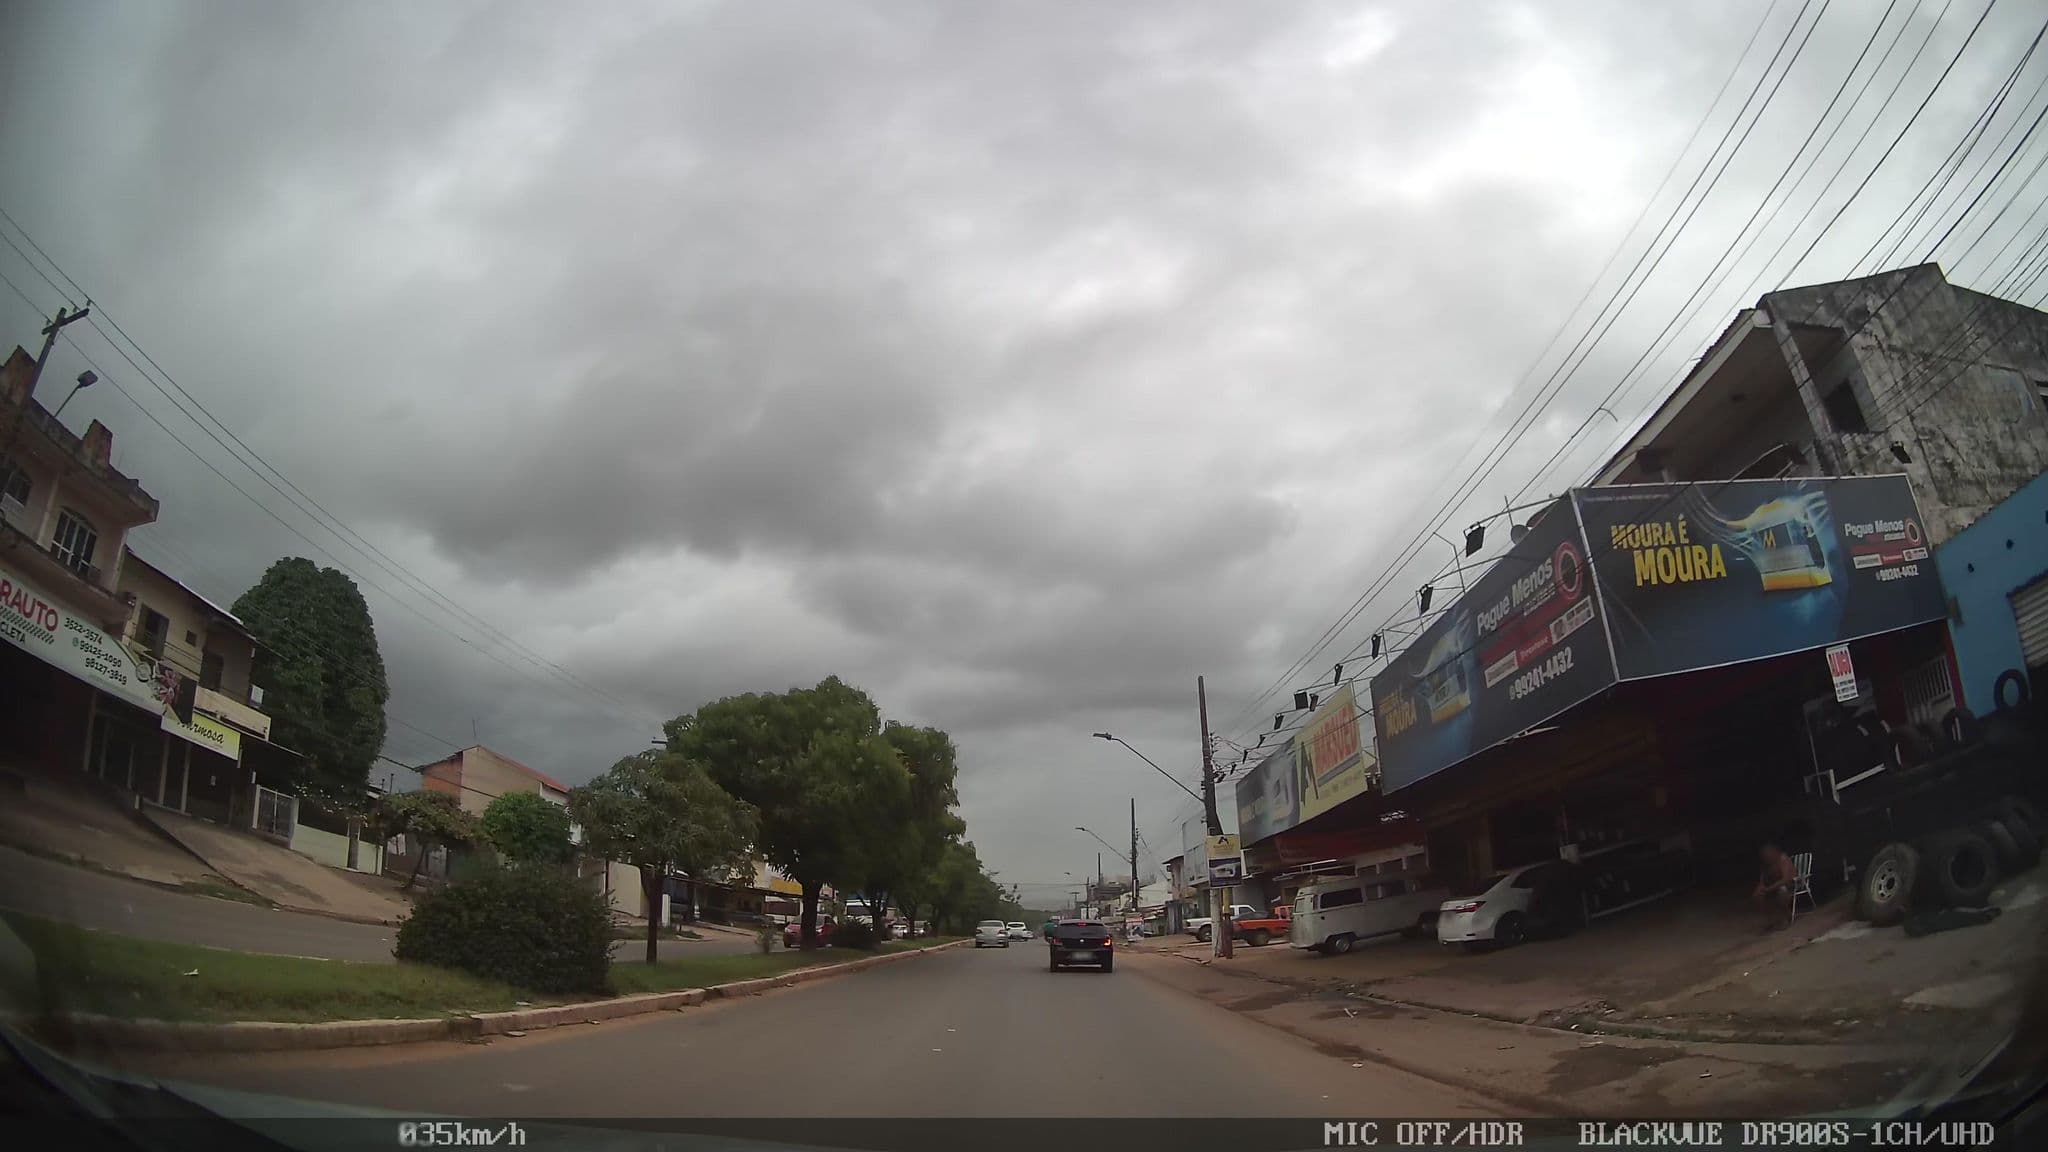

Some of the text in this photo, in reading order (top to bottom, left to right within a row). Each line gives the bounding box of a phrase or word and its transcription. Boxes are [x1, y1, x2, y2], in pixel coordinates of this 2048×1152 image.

[1611, 513, 1690, 549] MOURA É
[1844, 522, 1875, 538] Pague
[1875, 520, 1904, 533] Menos
[1633, 543, 1728, 587] MOURA
[1477, 595, 1510, 635] Pague
[1511, 557, 1554, 607] Menos
[64, 617, 102, 644] 3522-3574
[79, 640, 122, 668] 99125-1090
[85, 657, 127, 686] 98127-3819
[1514, 646, 1574, 699] 99241-4432
